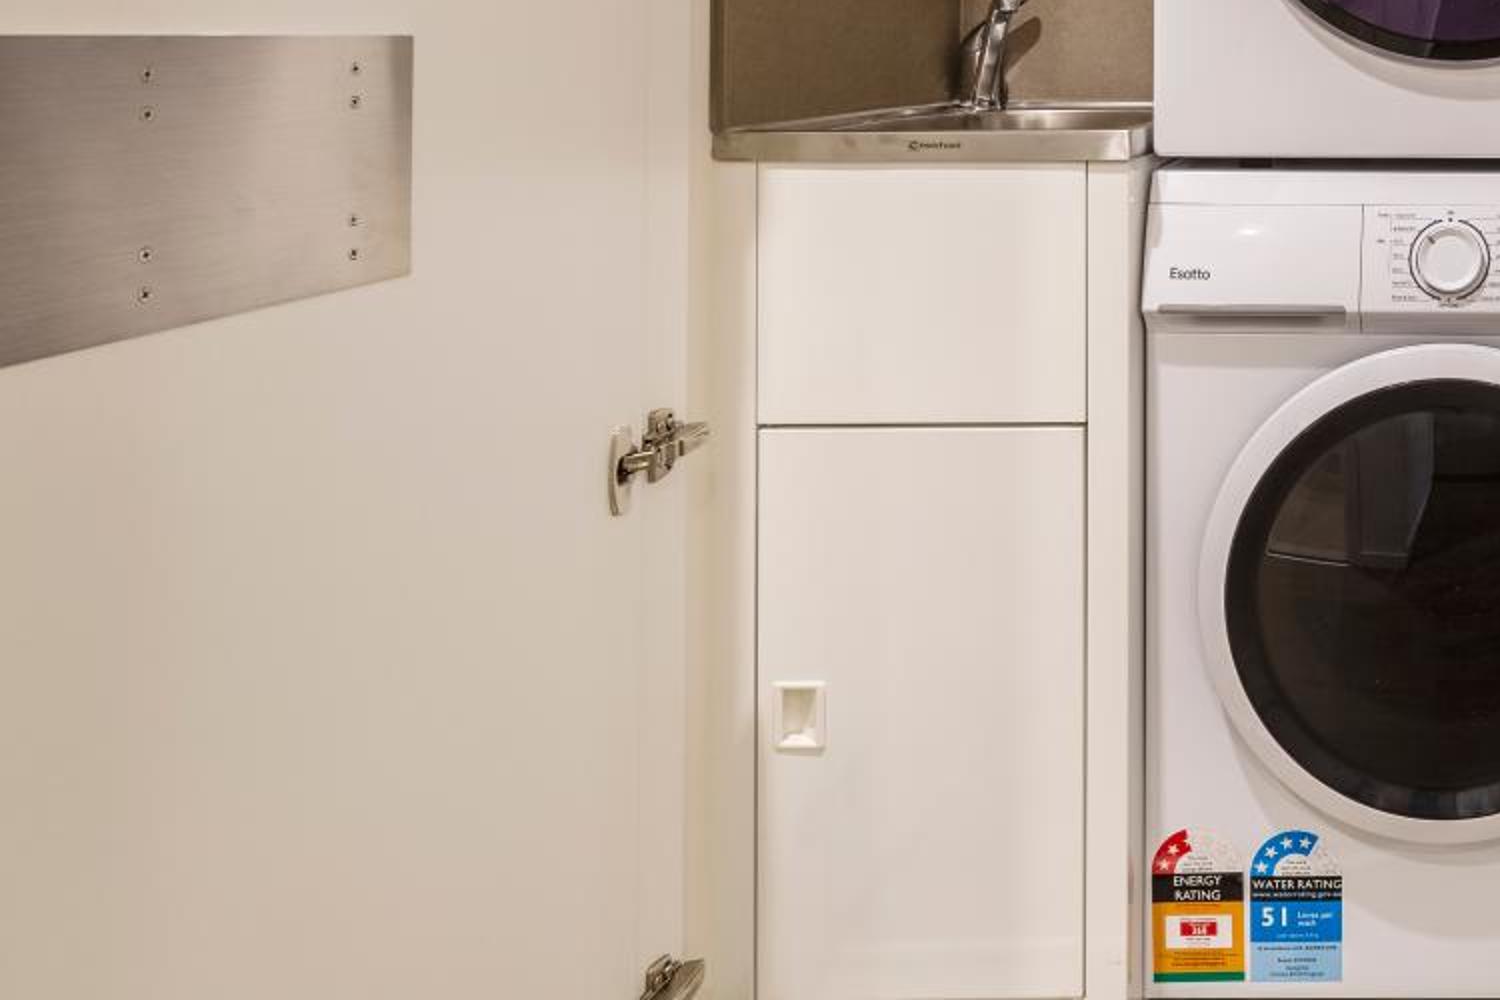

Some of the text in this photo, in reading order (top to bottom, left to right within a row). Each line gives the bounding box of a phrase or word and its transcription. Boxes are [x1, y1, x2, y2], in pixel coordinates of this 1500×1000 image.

[1169, 267, 1211, 280] Esotto
[1173, 875, 1222, 887] ENERGY
[1252, 879, 1343, 889] WATER RATING
[1174, 889, 1221, 901] RATING
